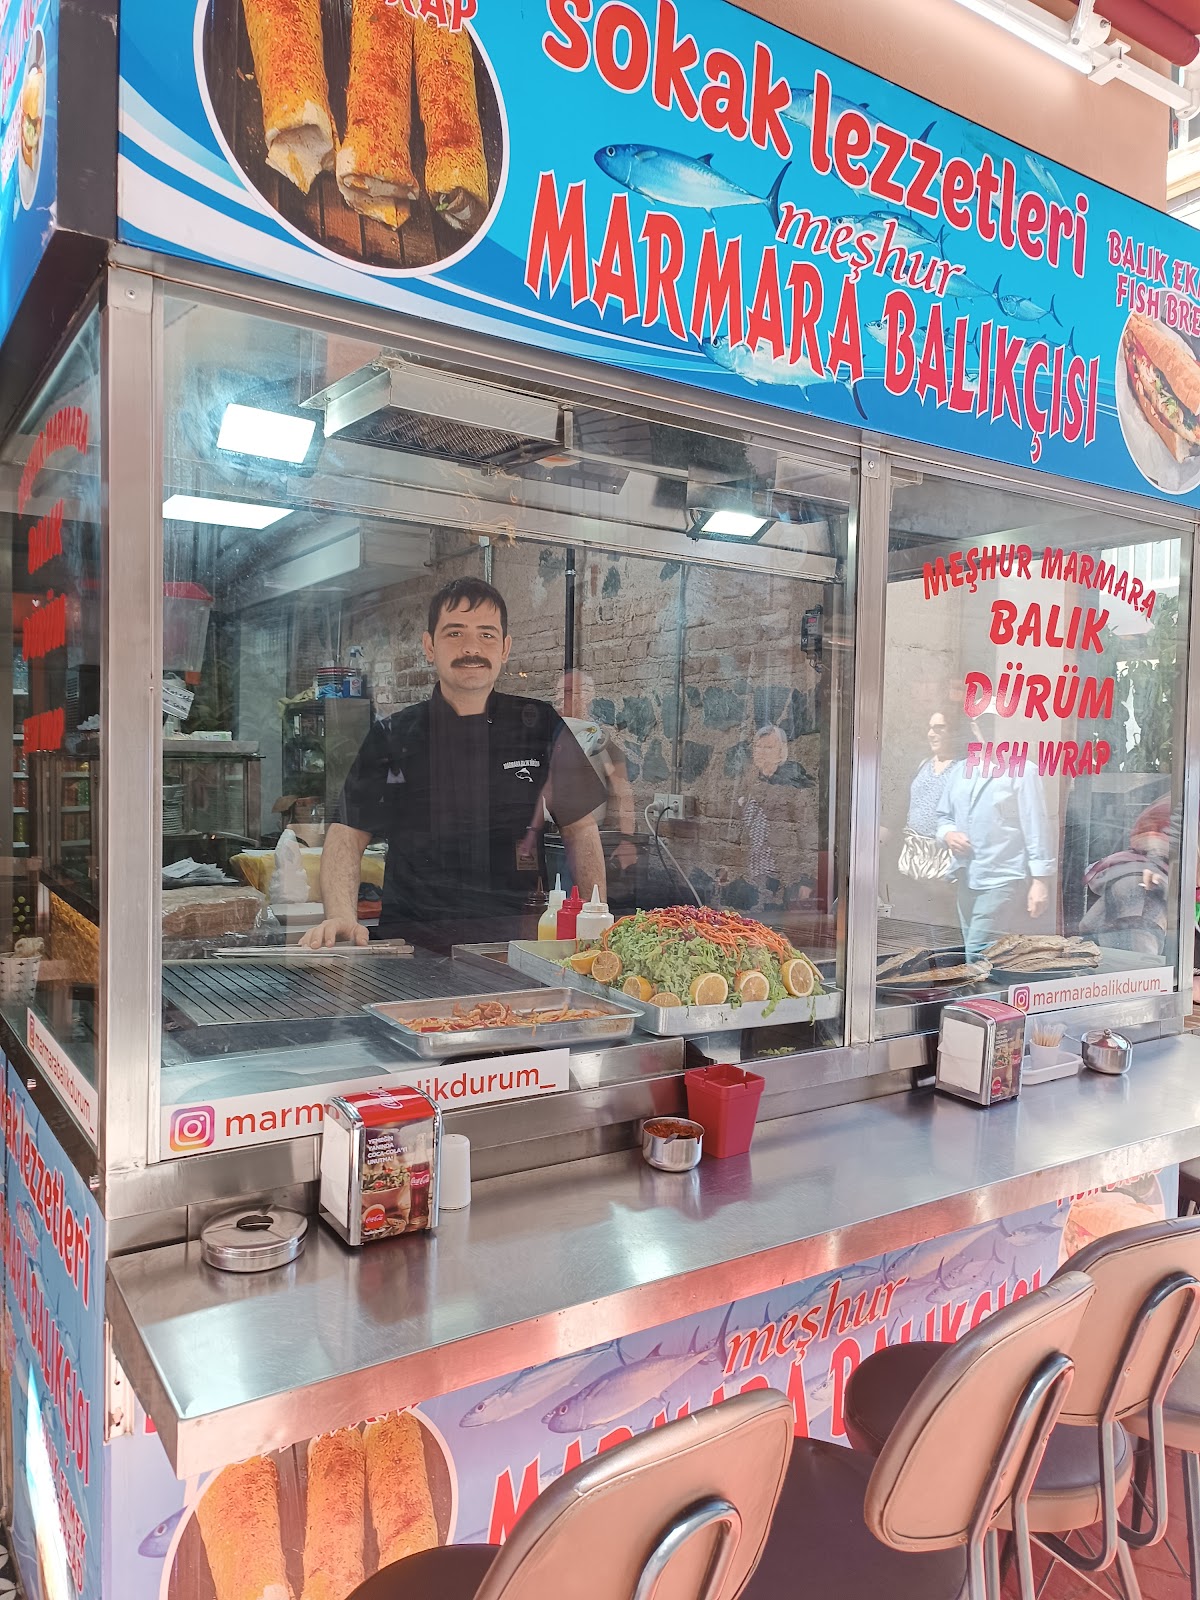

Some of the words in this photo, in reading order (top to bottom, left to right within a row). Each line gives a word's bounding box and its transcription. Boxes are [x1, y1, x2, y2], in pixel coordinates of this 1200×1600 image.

[810, 69, 1090, 279] lezzetleri
[776, 202, 966, 299] meşhur
[1106, 229, 1169, 288] BALIK
[1172, 259, 1200, 300] EK
[524, 170, 865, 386] MARMARA
[884, 289, 1099, 463] BALIKÇISI
[1116, 273, 1160, 321] FISH
[922, 544, 1032, 600] MEŞHUR
[1040, 546, 1157, 619] MARMARA
[989, 599, 1110, 654] BALIK
[963, 661, 1115, 722] DÜRÜM
[964, 741, 1029, 779] FISH
[1038, 740, 1111, 778] WRAP
[1033, 977, 1168, 1006] marmarabalikdurum_
[20, 1103, 91, 1311] lezzetleri
[722, 1276, 909, 1377] meşhur
